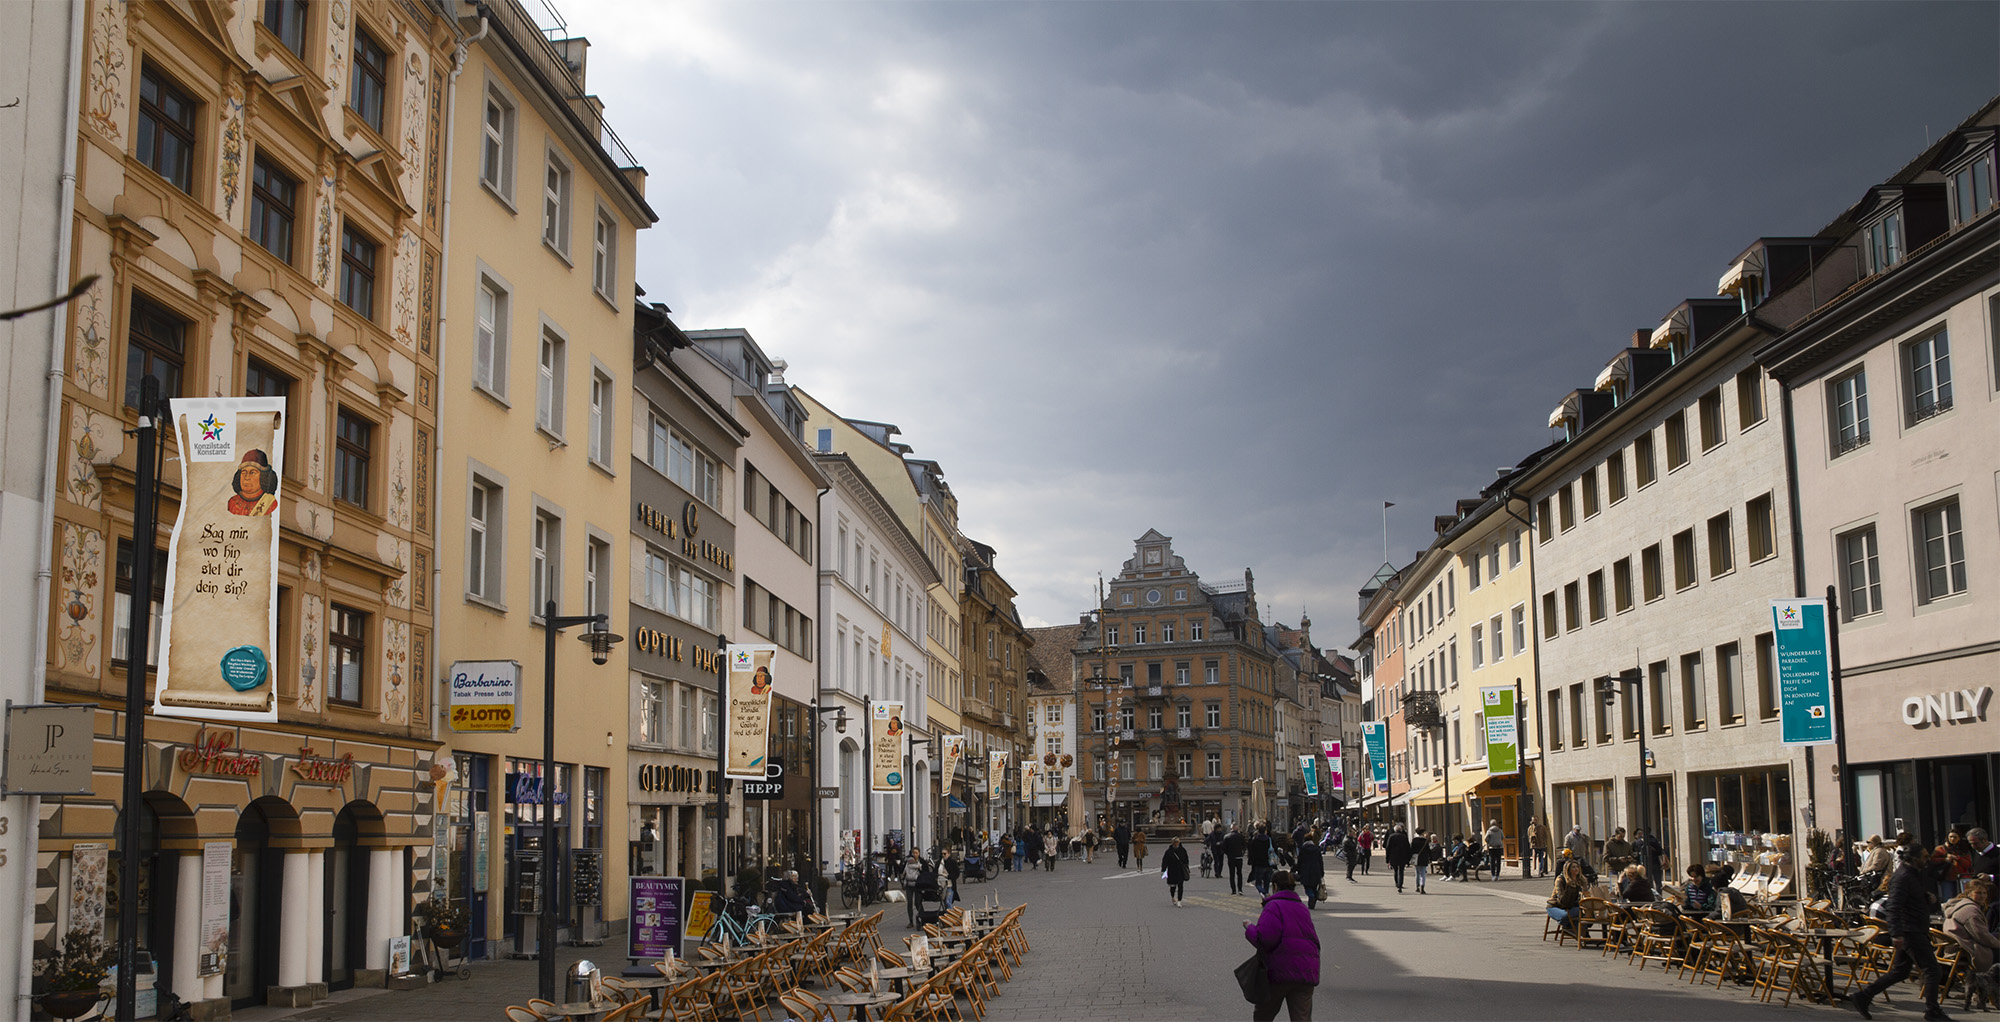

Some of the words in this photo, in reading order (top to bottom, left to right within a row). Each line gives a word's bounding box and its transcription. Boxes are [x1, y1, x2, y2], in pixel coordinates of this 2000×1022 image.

[194, 442, 230, 450] Konzilstadt
[198, 523, 225, 544] Sag
[638, 502, 677, 540] SEHEN
[683, 538, 698, 560] IST
[703, 539, 734, 572] LEBEN
[203, 547, 219, 558] wo
[227, 563, 243, 577] dir
[636, 626, 684, 662] OPTIK
[693, 645, 719, 674] PHO
[1902, 686, 1989, 726] ONLY
[470, 708, 512, 721] LOTTO
[43, 724, 64, 754] JP
[745, 783, 782, 794] HEPP
[635, 882, 679, 890] BEAUTYMIX
